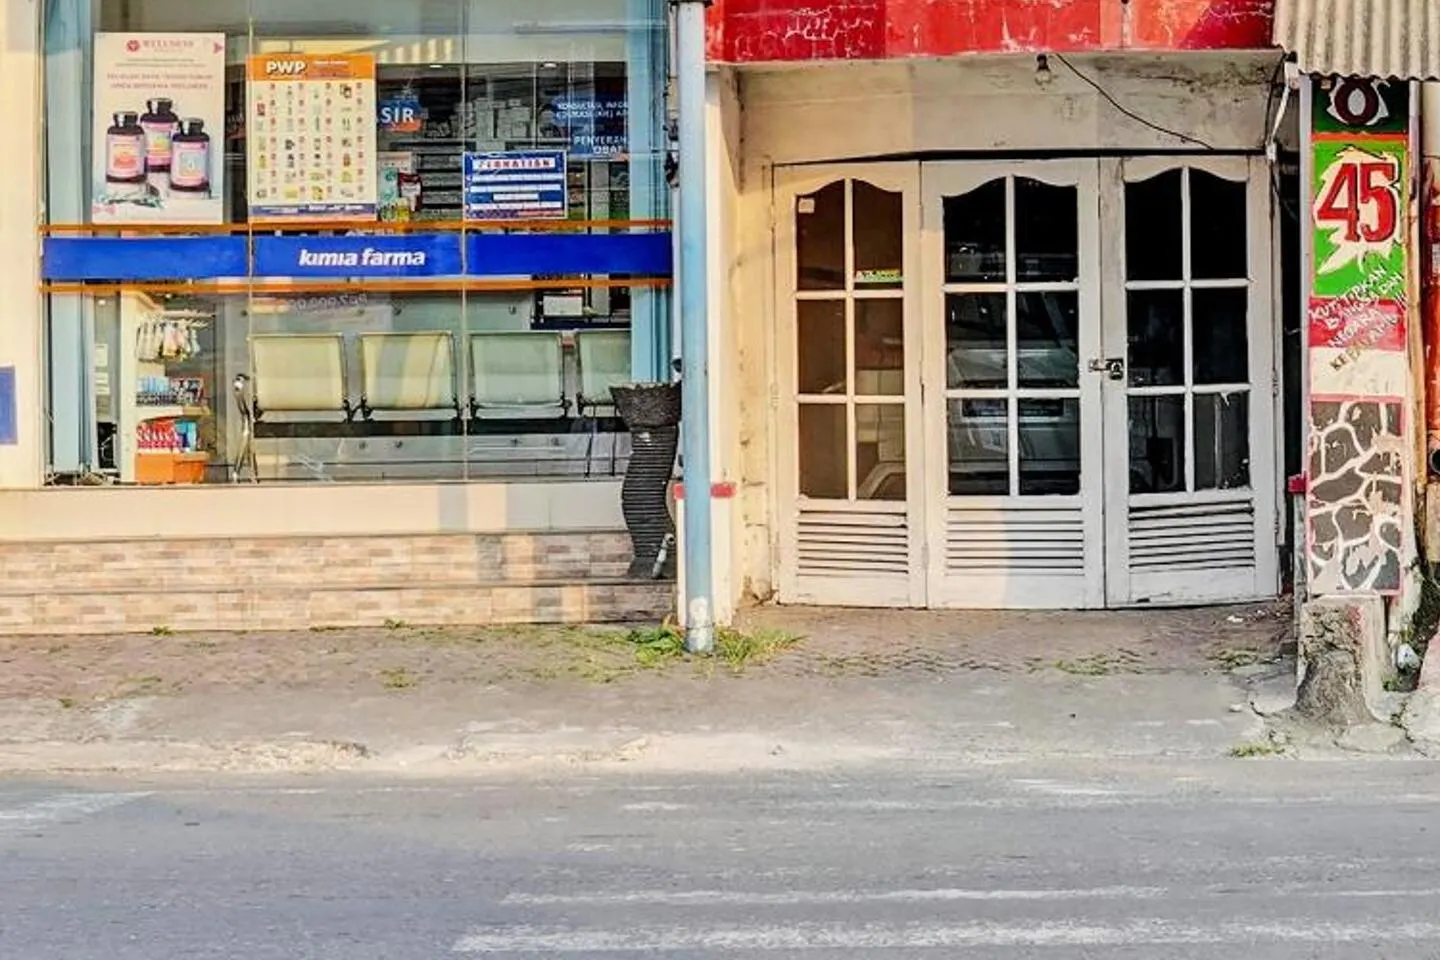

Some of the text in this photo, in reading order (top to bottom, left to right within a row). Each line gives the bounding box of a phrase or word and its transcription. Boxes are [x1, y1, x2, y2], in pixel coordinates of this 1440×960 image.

[266, 60, 306, 75] PWP
[377, 106, 415, 124] SIR
[1316, 162, 1398, 243] 45
[299, 247, 426, 267] kimia farma
